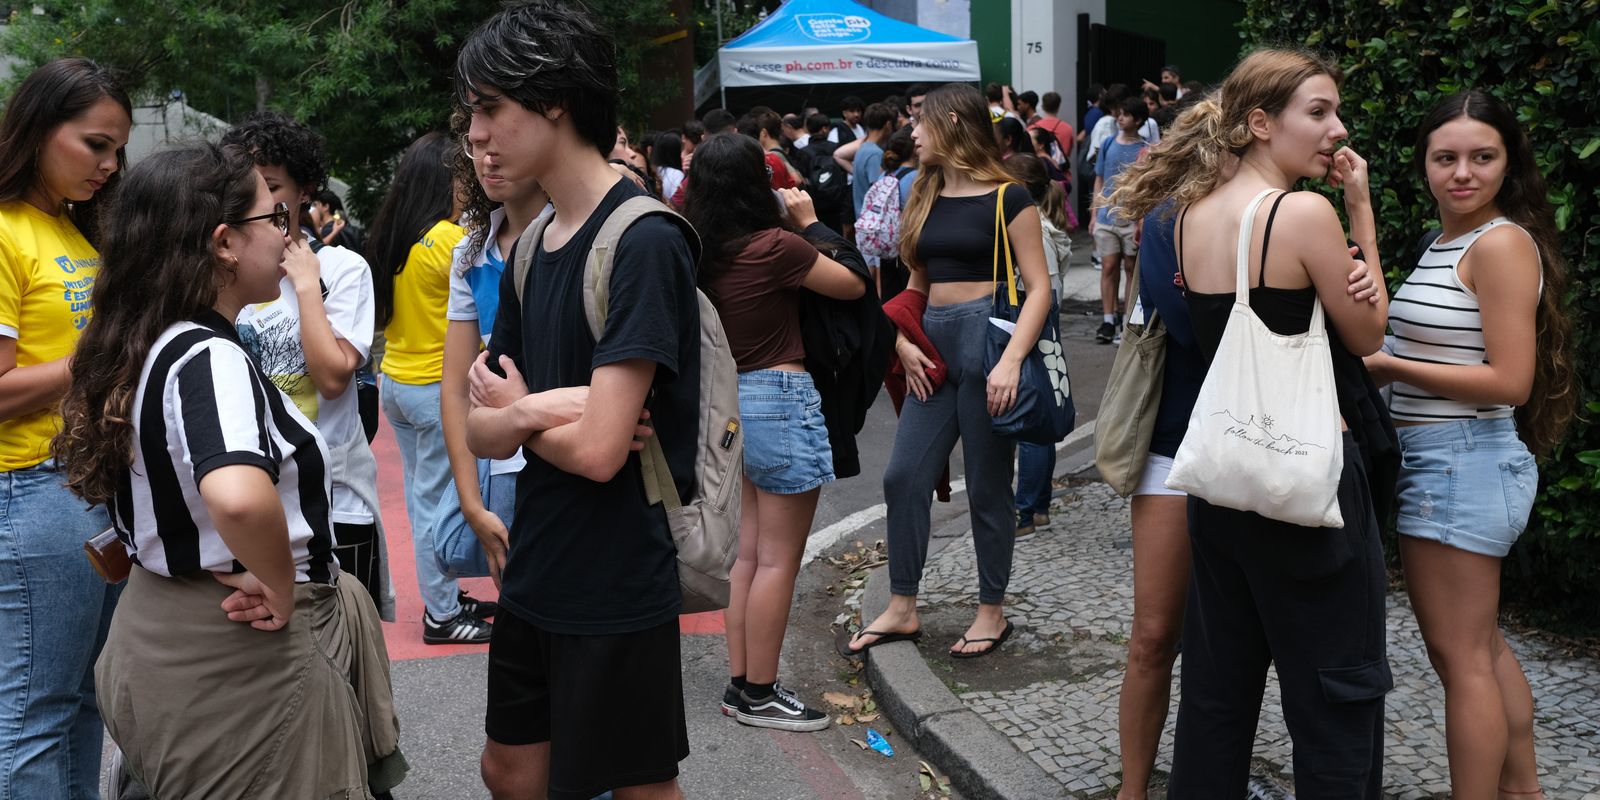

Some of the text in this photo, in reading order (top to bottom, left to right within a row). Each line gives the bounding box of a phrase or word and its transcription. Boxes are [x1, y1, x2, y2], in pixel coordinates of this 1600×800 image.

[1026, 41, 1042, 54] 75
[738, 57, 960, 73] Acesse ph.com.br e descubra como
[64, 290, 72, 301] É
[1265, 441, 1296, 455] beach
